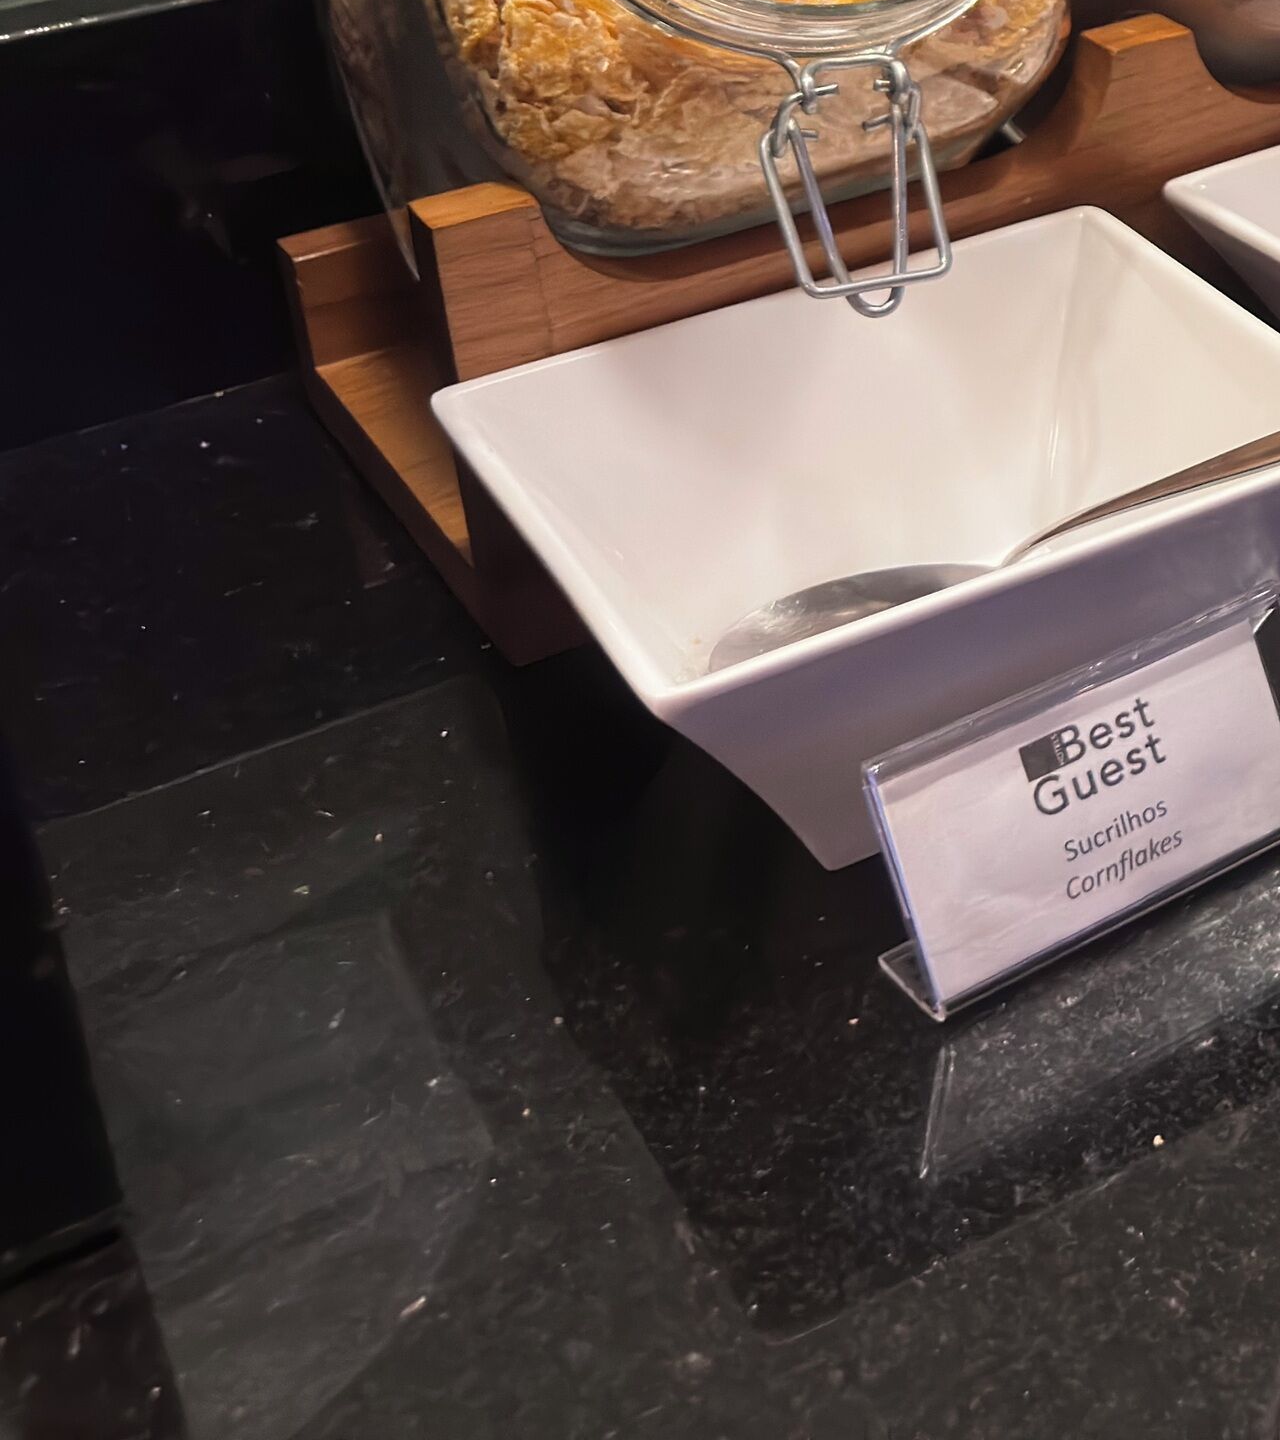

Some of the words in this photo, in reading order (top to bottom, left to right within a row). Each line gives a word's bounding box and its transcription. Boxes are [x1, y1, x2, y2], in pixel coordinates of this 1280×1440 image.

[1057, 697, 1156, 765] Best
[1033, 734, 1167, 815] Guest
[1064, 800, 1168, 862] Sucrilhos
[1066, 830, 1183, 900] Cornflakes
